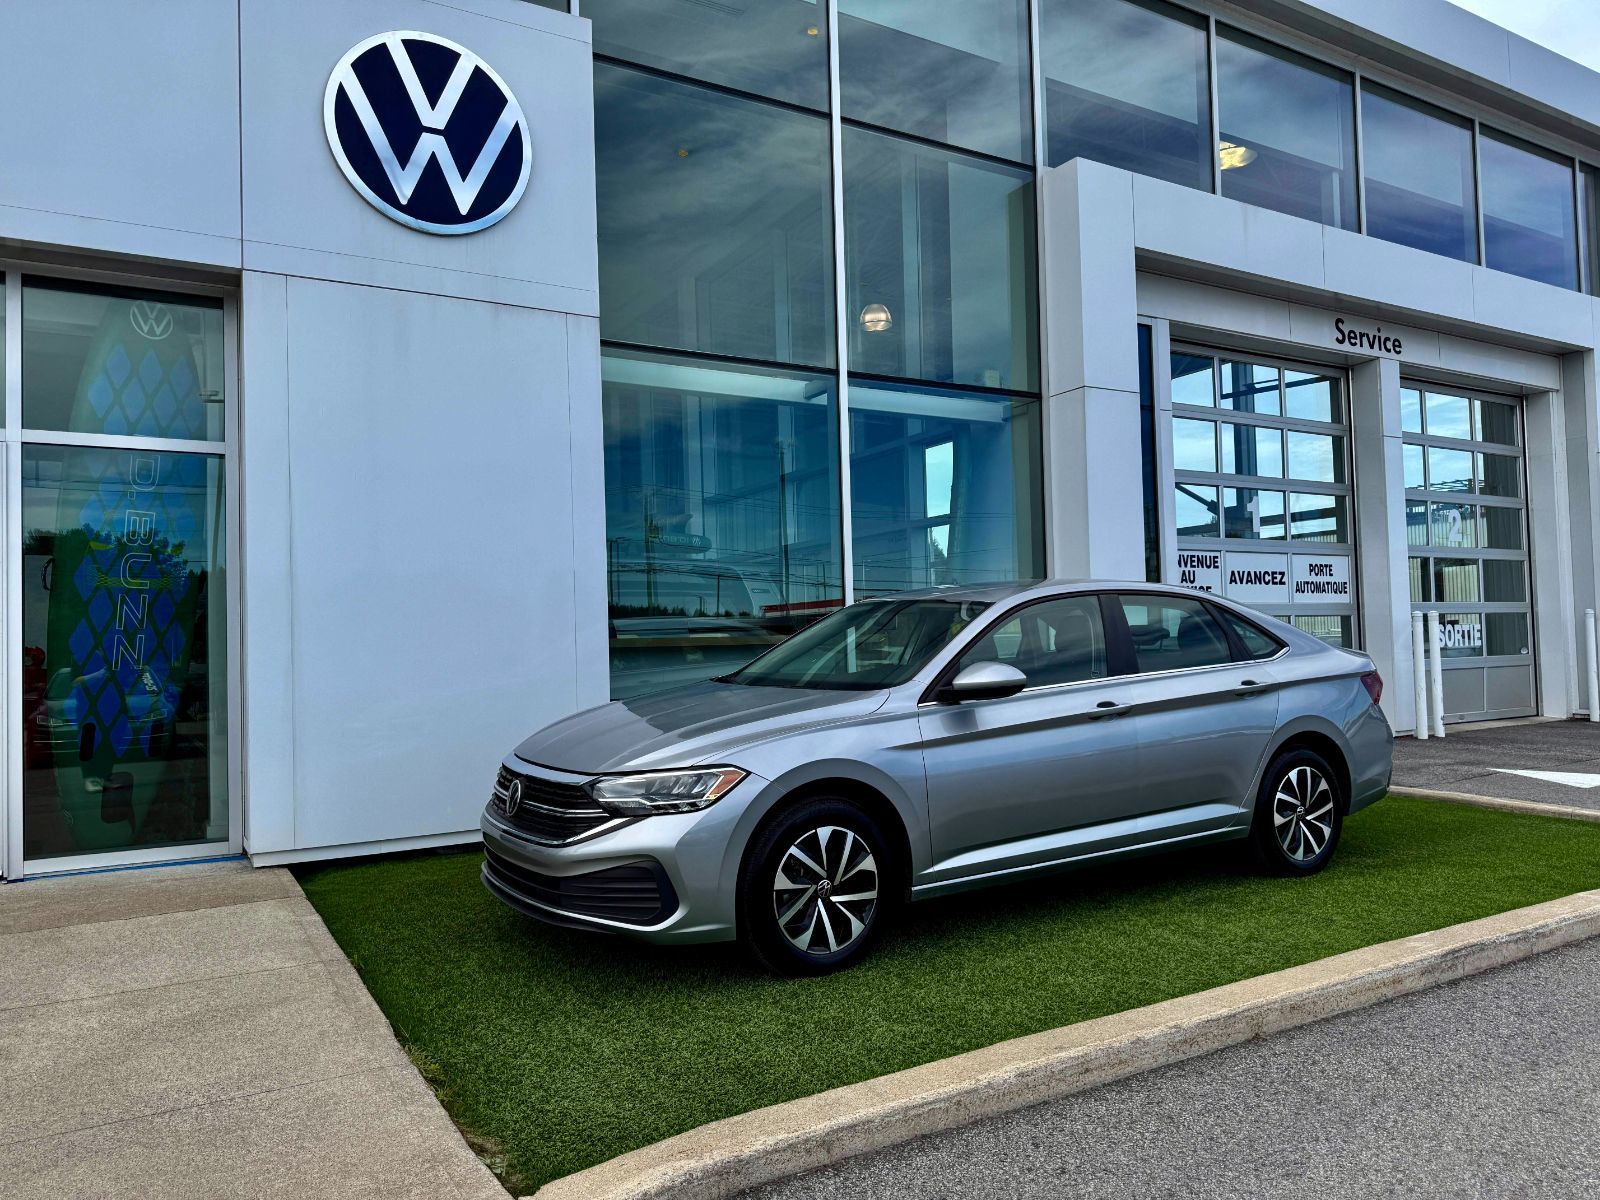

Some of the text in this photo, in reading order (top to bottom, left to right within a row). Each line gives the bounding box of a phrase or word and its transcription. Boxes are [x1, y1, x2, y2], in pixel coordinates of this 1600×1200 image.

[331, 33, 525, 217] VW
[1335, 317, 1402, 355] Service
[1246, 496, 1260, 533] 1
[1448, 508, 1463, 542] 2
[1181, 570, 1196, 584] AU
[1229, 570, 1287, 586] AVANCEZ
[1308, 563, 1334, 577] PORTE
[1295, 581, 1348, 595] AUTOMATIQUE
[1438, 623, 1482, 649] SORTIE
